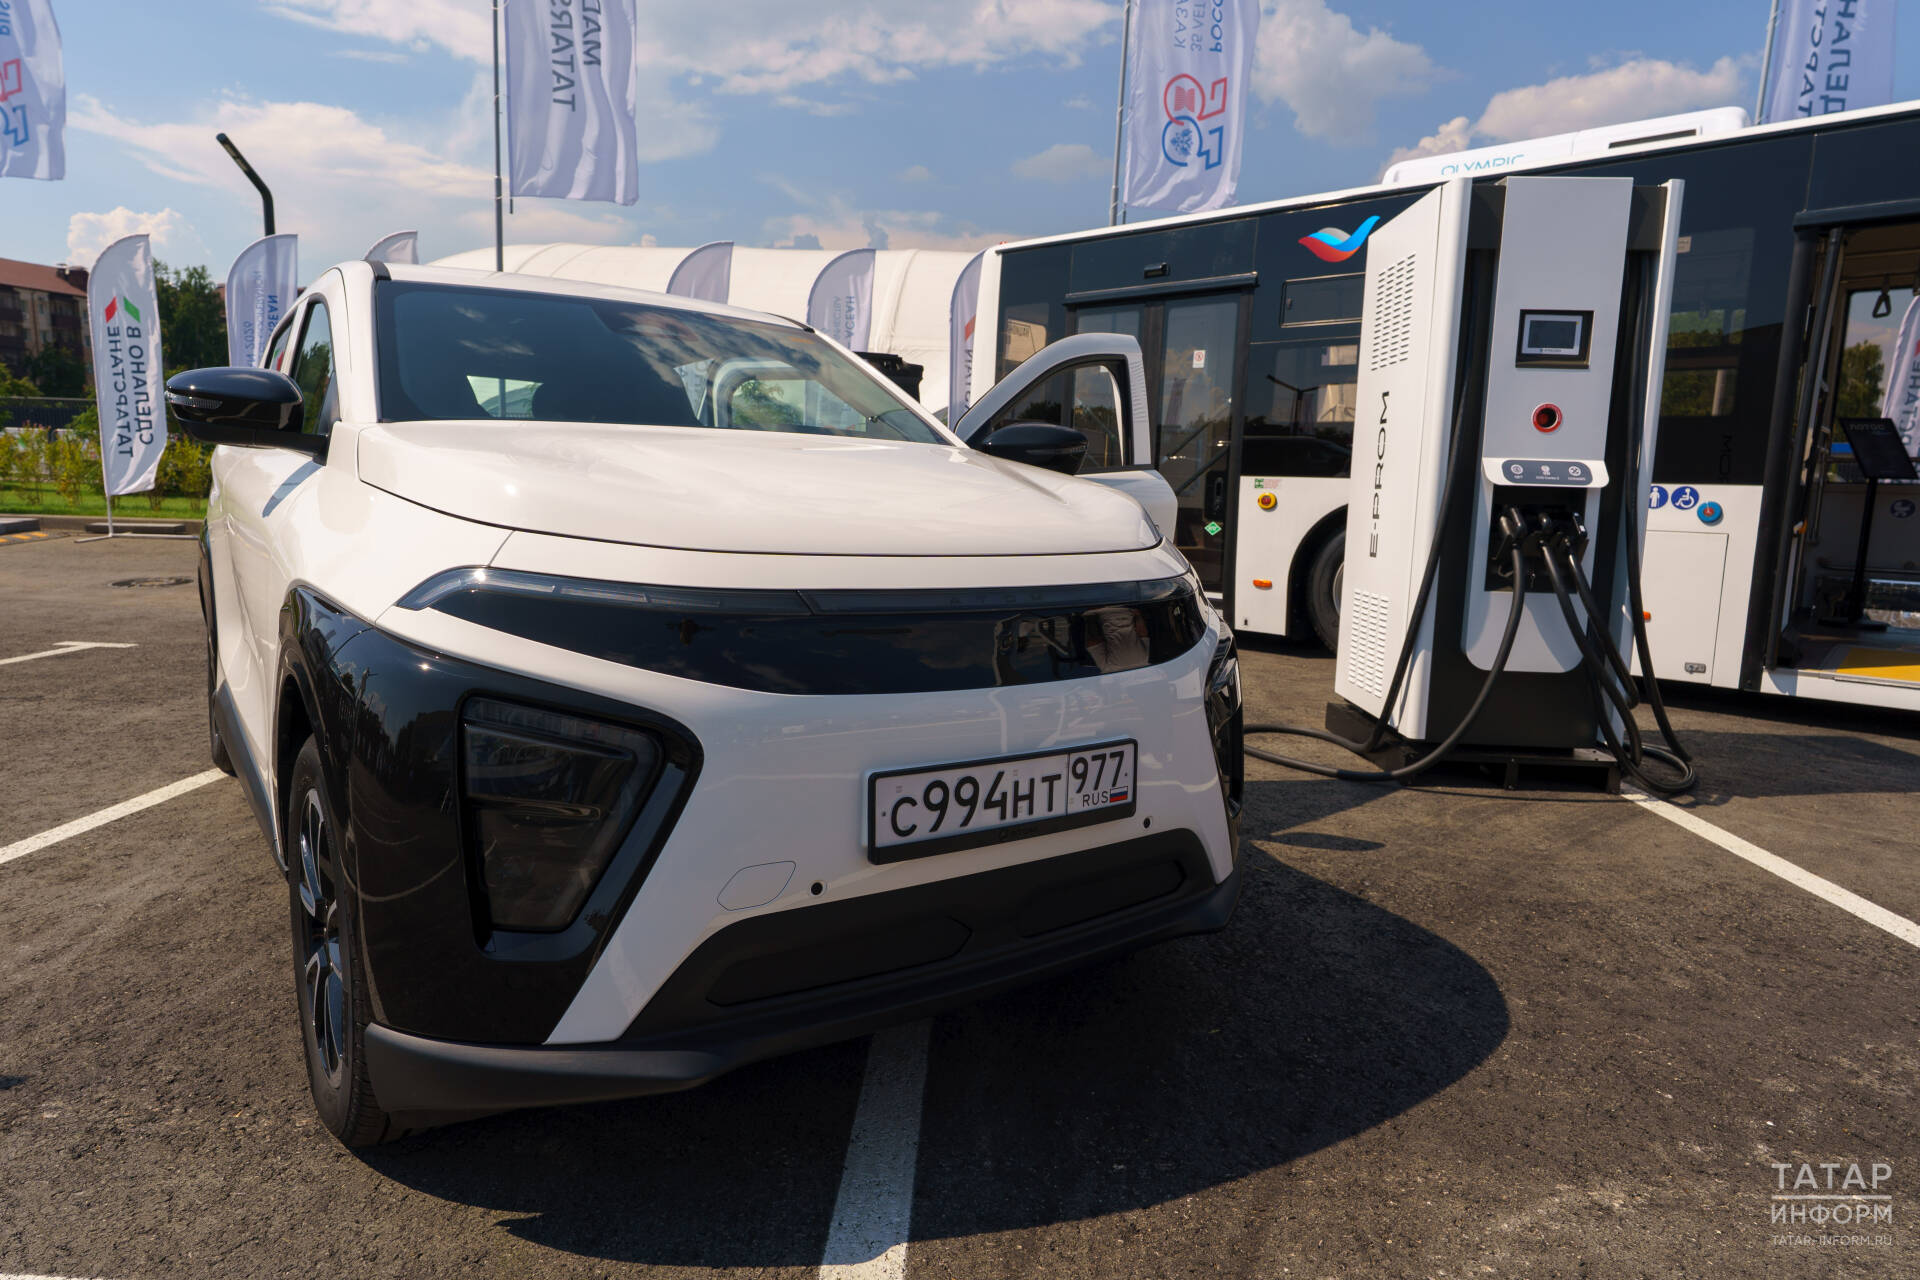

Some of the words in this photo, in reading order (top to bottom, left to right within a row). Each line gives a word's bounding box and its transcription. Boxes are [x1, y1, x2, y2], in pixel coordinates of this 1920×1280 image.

[1369, 391, 1389, 558] E-PROM
[1071, 751, 1125, 794] 977
[1082, 789, 1109, 808] RUS
[891, 771, 1062, 837] С994НТ
